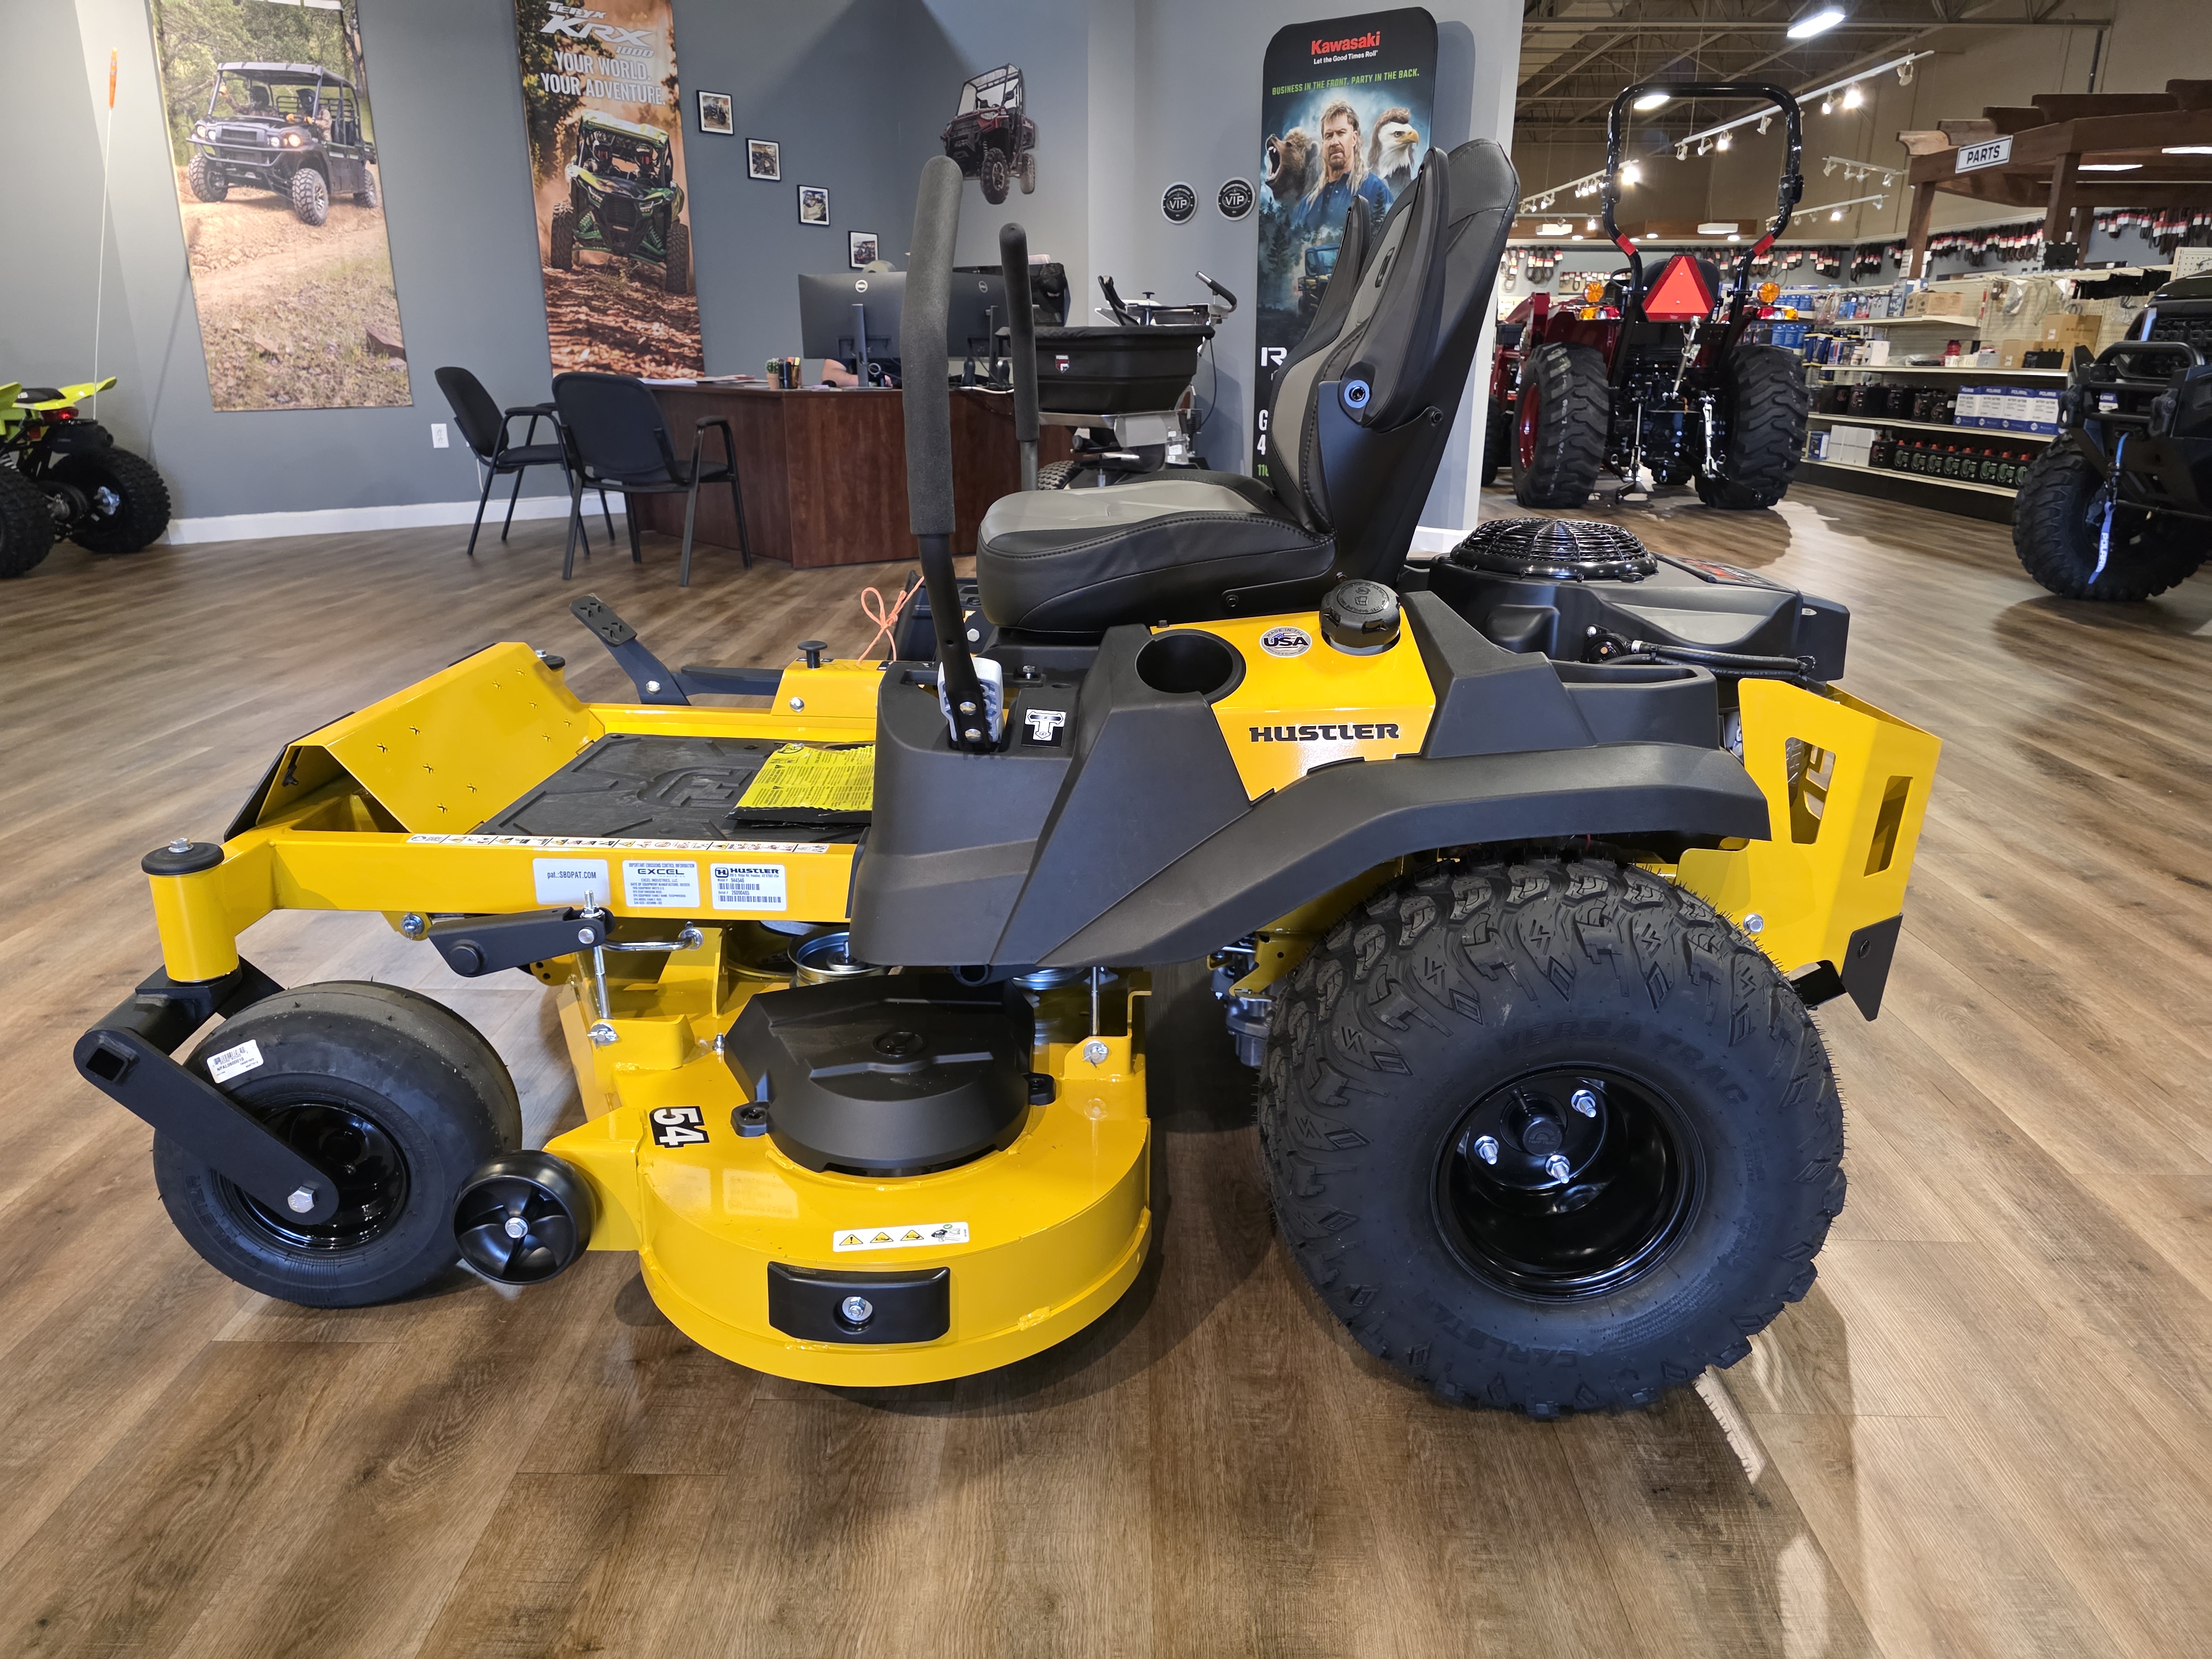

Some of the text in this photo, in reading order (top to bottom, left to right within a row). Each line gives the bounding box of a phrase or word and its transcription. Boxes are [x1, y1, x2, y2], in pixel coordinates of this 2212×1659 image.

[540, 14, 654, 48] KRX
[616, 46, 654, 58] 1000
[1311, 31, 1380, 55] Kawasaki
[554, 51, 651, 81] YOUR WORLD.
[540, 72, 665, 105] YOUR ADVENTURE.
[1272, 68, 1420, 95] BUSINESS IN THE FRONT. PARTY IN THE BACK.
[1966, 145, 2000, 164] PARTS
[1169, 200, 1187, 209] VIP
[1225, 195, 1244, 205] VIP
[1264, 637, 1309, 647] USA
[1266, 628, 1282, 637] MADE
[1249, 723, 1399, 742] HUSTLER
[1496, 1020, 1749, 1105] VERSA TRAC
[653, 1108, 705, 1146] 54
